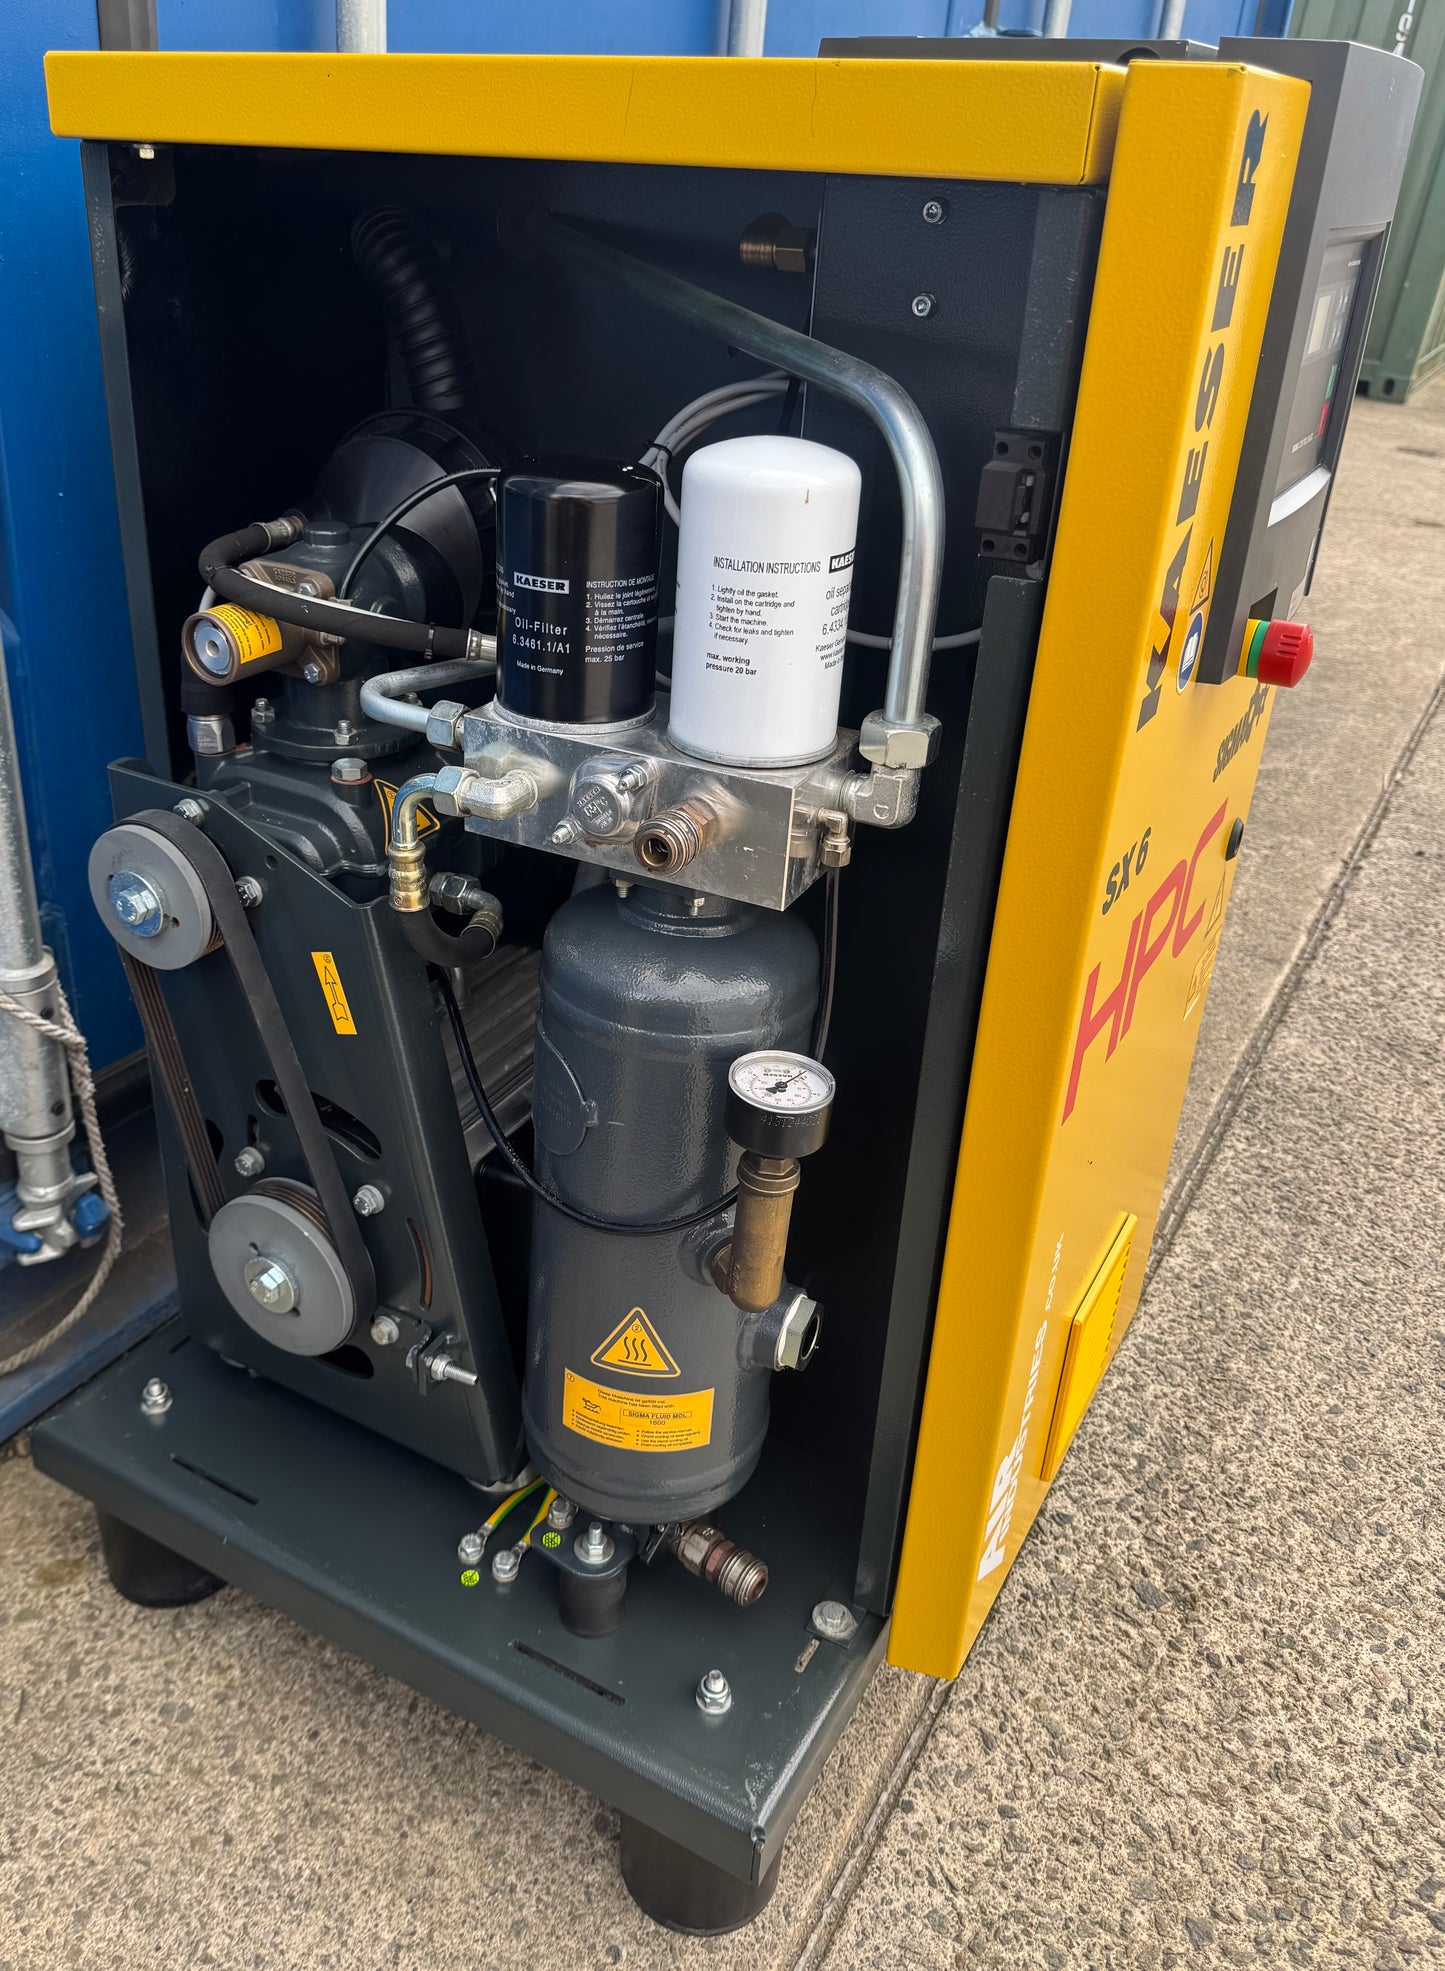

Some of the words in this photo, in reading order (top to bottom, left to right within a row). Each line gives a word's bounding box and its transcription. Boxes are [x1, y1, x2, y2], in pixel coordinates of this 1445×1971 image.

[1136, 109, 1270, 733] KAESER
[713, 556, 765, 574] INSTALLATION
[766, 560, 821, 574] INSTRUCTIONS
[516, 574, 566, 591] KAESER
[586, 579, 628, 589] INSTRUCTION
[628, 578, 636, 586] DE
[717, 585, 737, 596] Lightly
[737, 588, 745, 596] oil
[745, 589, 756, 597] the
[825, 586, 836, 601] oil
[716, 594, 734, 604] Install
[744, 598, 754, 607] the
[755, 600, 782, 610] cartridge
[783, 600, 796, 608] and
[716, 604, 735, 614] tighten
[736, 606, 744, 616] by
[515, 616, 568, 636] Oil-Filter
[715, 613, 729, 622] Start
[730, 616, 740, 624] the
[715, 623, 733, 633] Check
[733, 625, 742, 634] for
[743, 627, 760, 636] leaks
[760, 628, 773, 636] and
[773, 629, 794, 638] tighten
[512, 633, 570, 654] 6.3461.1/A1
[585, 645, 615, 653] Pression
[815, 641, 834, 653] Kaeser
[614, 654, 625, 662] bar
[722, 655, 751, 666] working
[516, 660, 530, 670] Made
[537, 664, 564, 676] Germany
[705, 661, 734, 674] pressure
[735, 666, 744, 675] 20
[745, 666, 758, 676] bar
[1102, 841, 1138, 916] SX
[1135, 826, 1151, 877] 6
[1061, 797, 1228, 1127] HPC
[628, 1411, 650, 1419] SIGMA
[998, 1320, 1048, 1544] INDUSTRIES
[977, 1435, 1020, 1582] AIR
